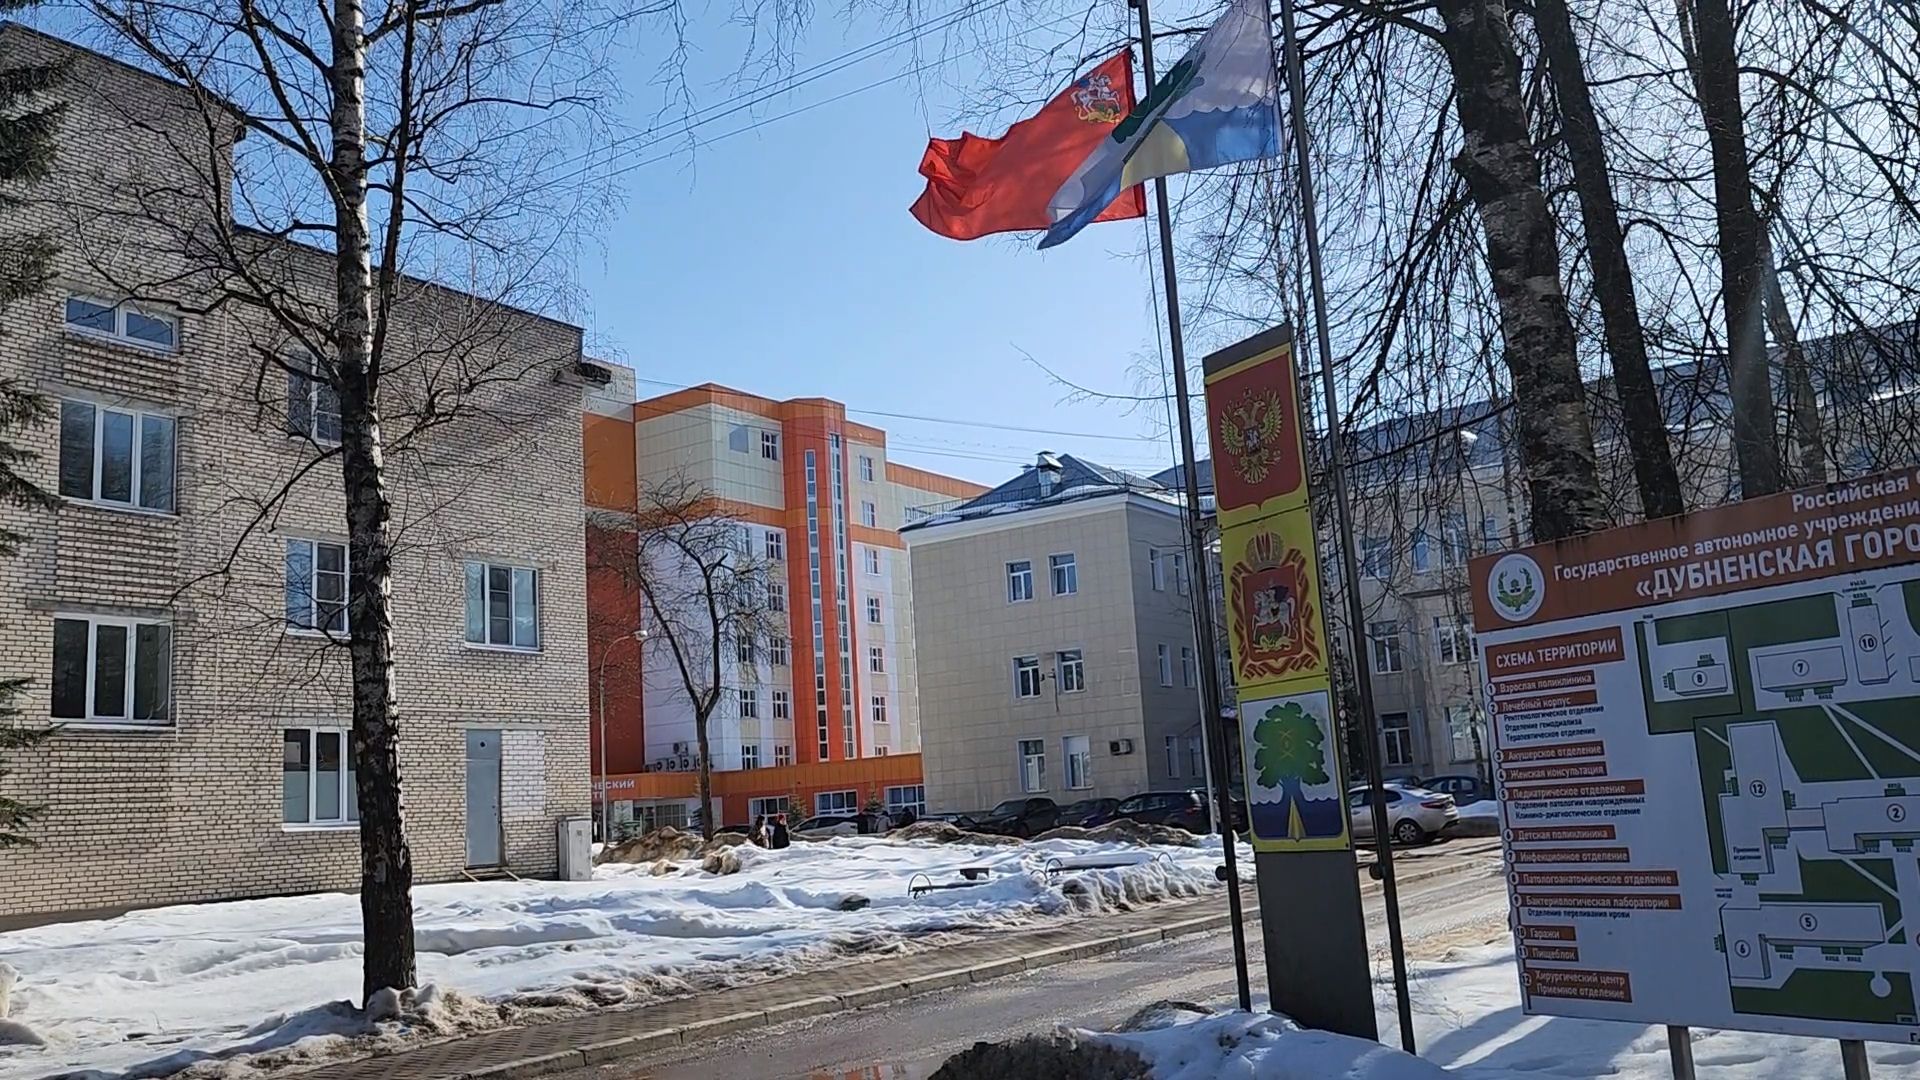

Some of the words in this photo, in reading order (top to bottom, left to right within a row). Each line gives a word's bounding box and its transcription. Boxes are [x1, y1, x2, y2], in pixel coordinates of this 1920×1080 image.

[1792, 476, 1909, 512] Российская
[1554, 544, 1689, 581] Государственное
[1694, 524, 1799, 556] автономное
[1804, 500, 1920, 539] учреждени
[1635, 539, 1835, 600] «ДУБНЕНСКАЯ
[1862, 638, 1874, 649] 10
[1496, 651, 1535, 668] СХЕМА
[1537, 638, 1617, 662] ТЕРРИТОРИИ
[1798, 663, 1804, 673] 7
[1500, 680, 1536, 695] Взрослая
[1538, 673, 1592, 689] поликлиника
[1503, 698, 1542, 713] Лечебный
[1543, 696, 1571, 710] корпус
[1504, 709, 1567, 722] Рентгенологическое
[1569, 704, 1604, 716] отделение
[1505, 722, 1538, 733] Отделение
[1540, 718, 1582, 730] гемодиализа
[1506, 731, 1559, 743] Терапевтическое
[1561, 727, 1596, 738] отделение
[1508, 748, 1555, 762] Акушерское
[1557, 744, 1601, 758] отделение
[1510, 768, 1545, 780] Женская
[1547, 764, 1604, 779] консультация
[1513, 786, 1578, 800] Педиатрическое
[1580, 783, 1626, 797] отделение
[1752, 784, 1763, 794] 12
[1514, 801, 1548, 811] Отделение
[1550, 799, 1583, 809] патологии
[1515, 809, 1602, 820] Клинико-диагностическое
[1603, 808, 1641, 818] отделение
[1892, 807, 1900, 819] 2
[1519, 829, 1550, 841] Детская
[1552, 829, 1608, 840] поликлиника
[1519, 851, 1580, 864] Инфекционное
[1582, 850, 1628, 863] отделение
[1523, 873, 1621, 886] Патологоанатомическое
[1624, 874, 1672, 887] отделение
[1526, 895, 1611, 907] Бактериологическая
[1613, 897, 1669, 909] лаборатория
[1528, 908, 1561, 918] Отделение
[1563, 909, 1607, 919] переливания
[1609, 910, 1630, 920] крови
[1805, 917, 1812, 928] 5
[1530, 928, 1560, 939] Гаражи
[1532, 947, 1576, 960] Пищеблок
[1740, 944, 1746, 954] 6
[1535, 969, 1598, 984] Хирургический
[1600, 974, 1625, 987] центр
[1536, 983, 1578, 996] Приемное
[1579, 987, 1625, 1000] отделение
